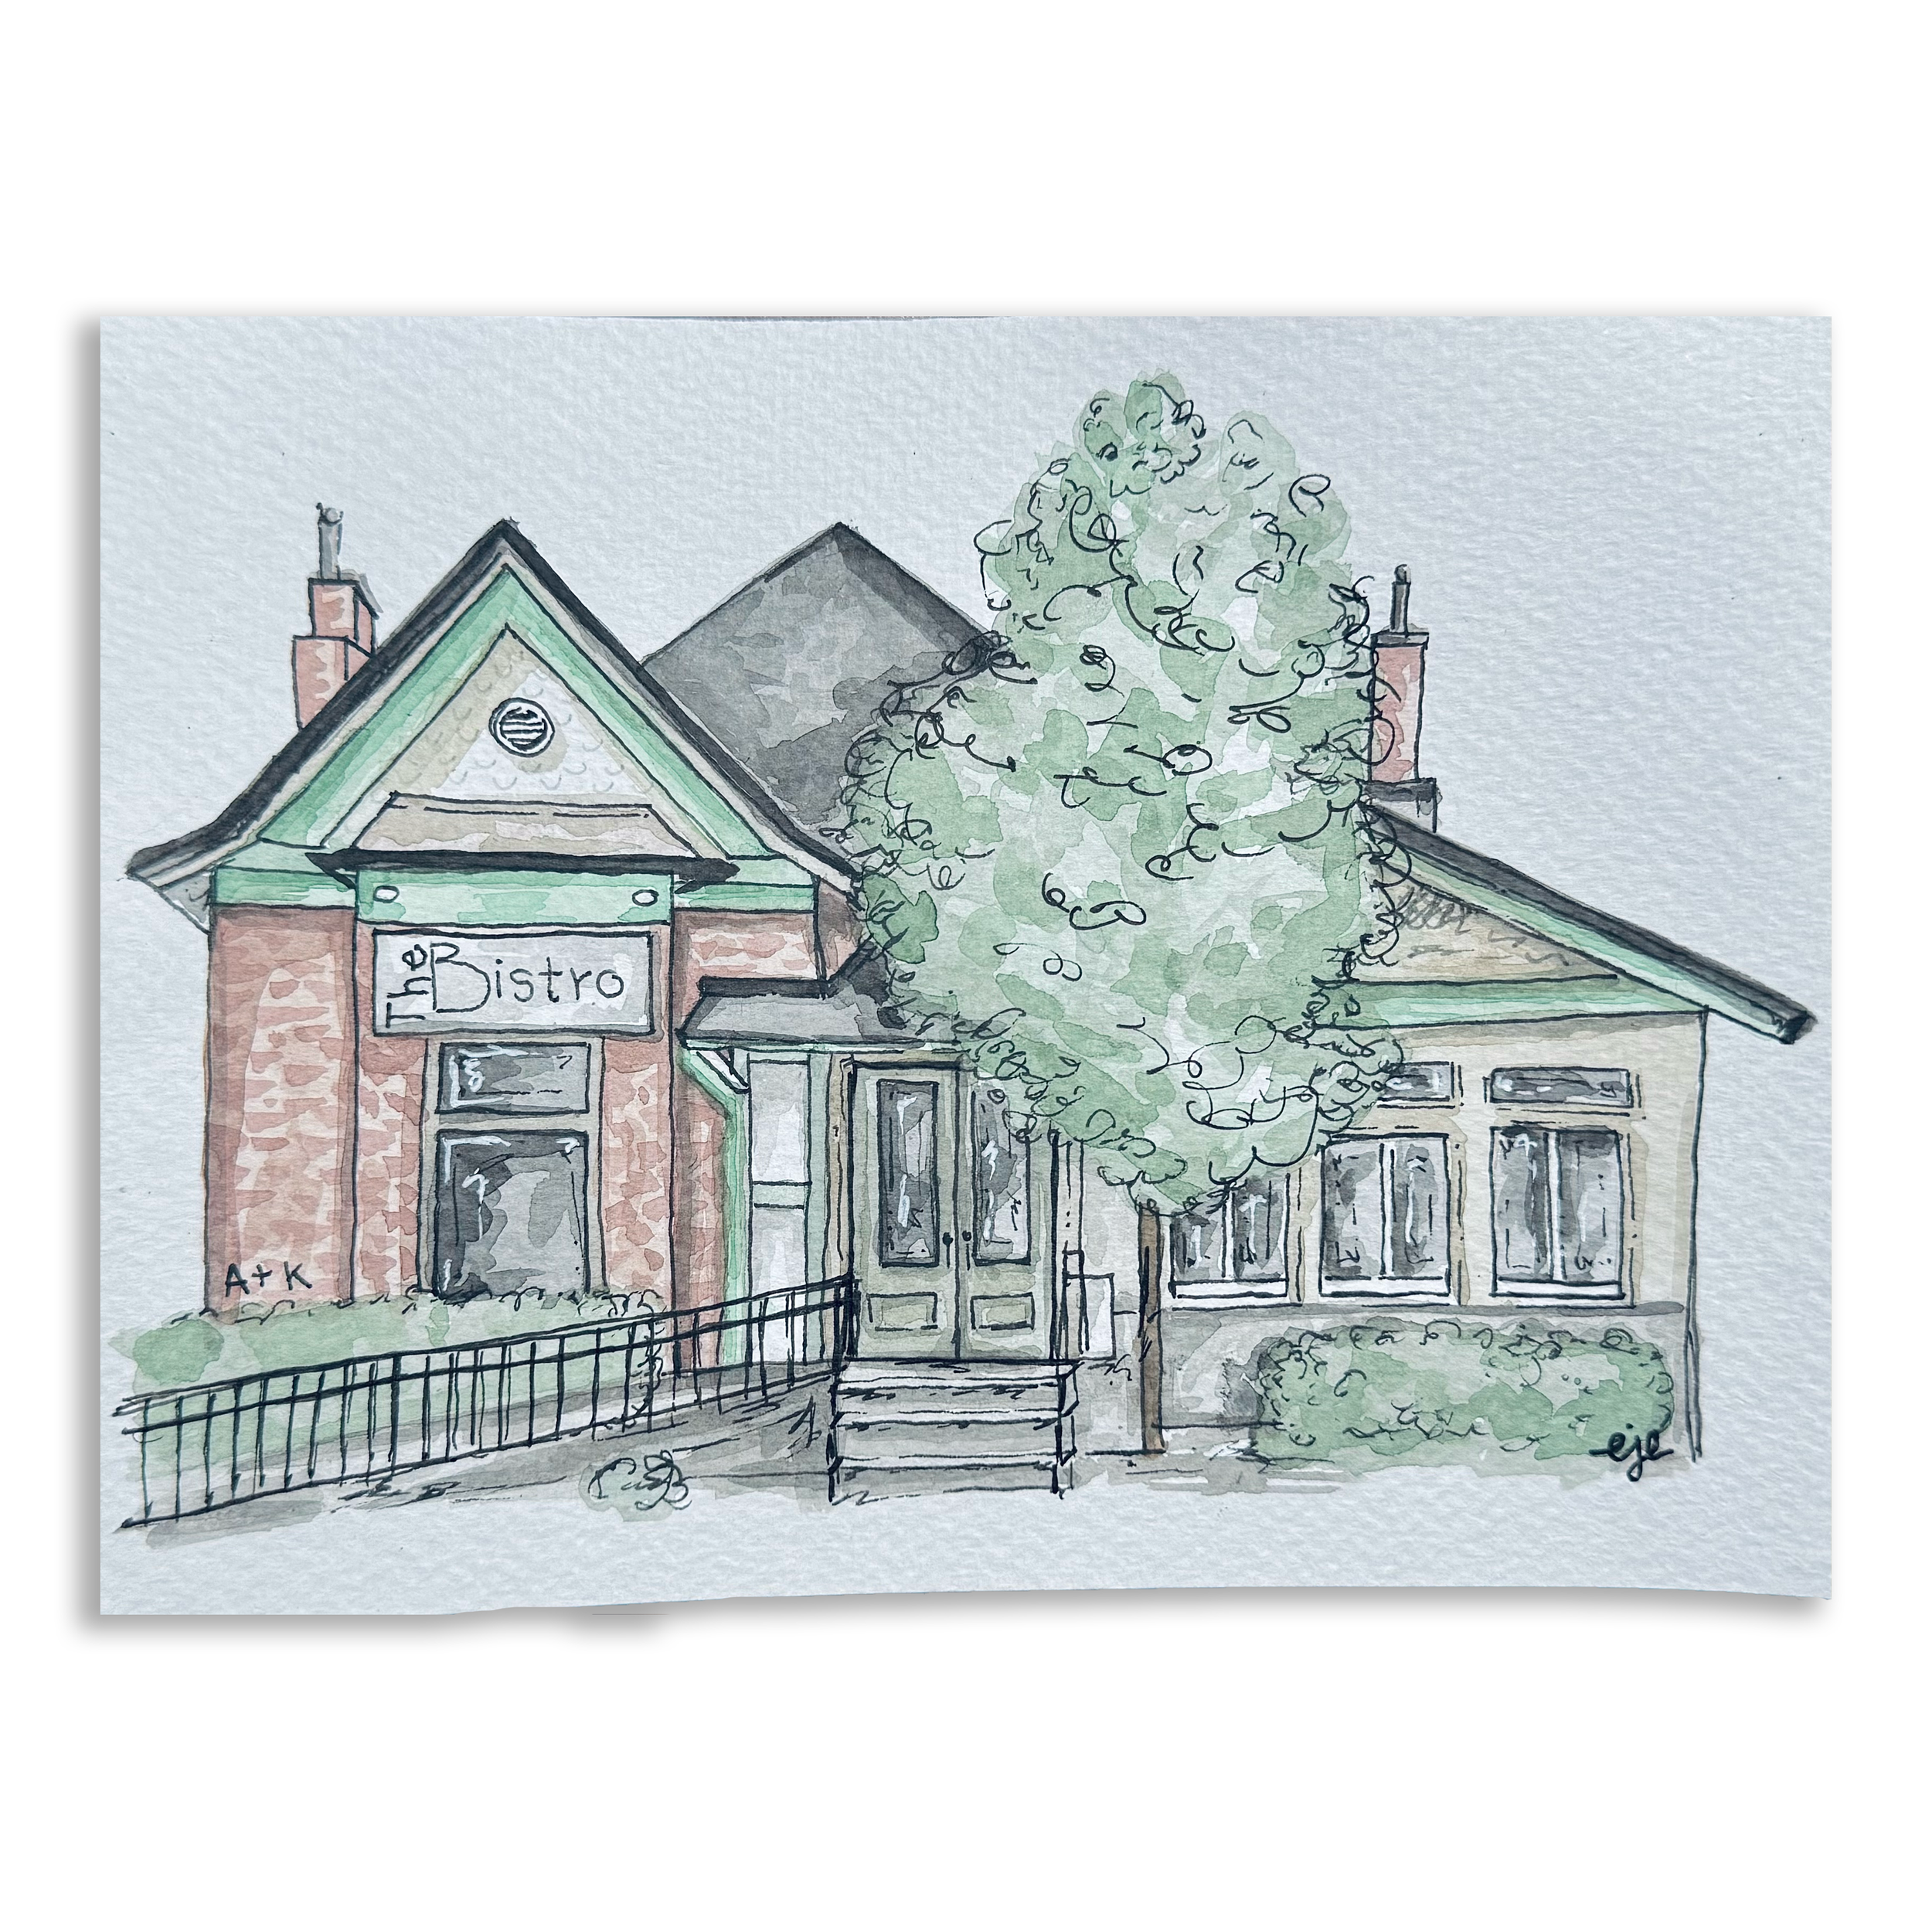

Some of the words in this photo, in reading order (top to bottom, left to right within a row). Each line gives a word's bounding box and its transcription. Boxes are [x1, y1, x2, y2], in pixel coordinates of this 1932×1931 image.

[386, 943, 431, 1028] The
[430, 941, 624, 1013] Bistro
[1588, 1423, 1675, 1482] eje
